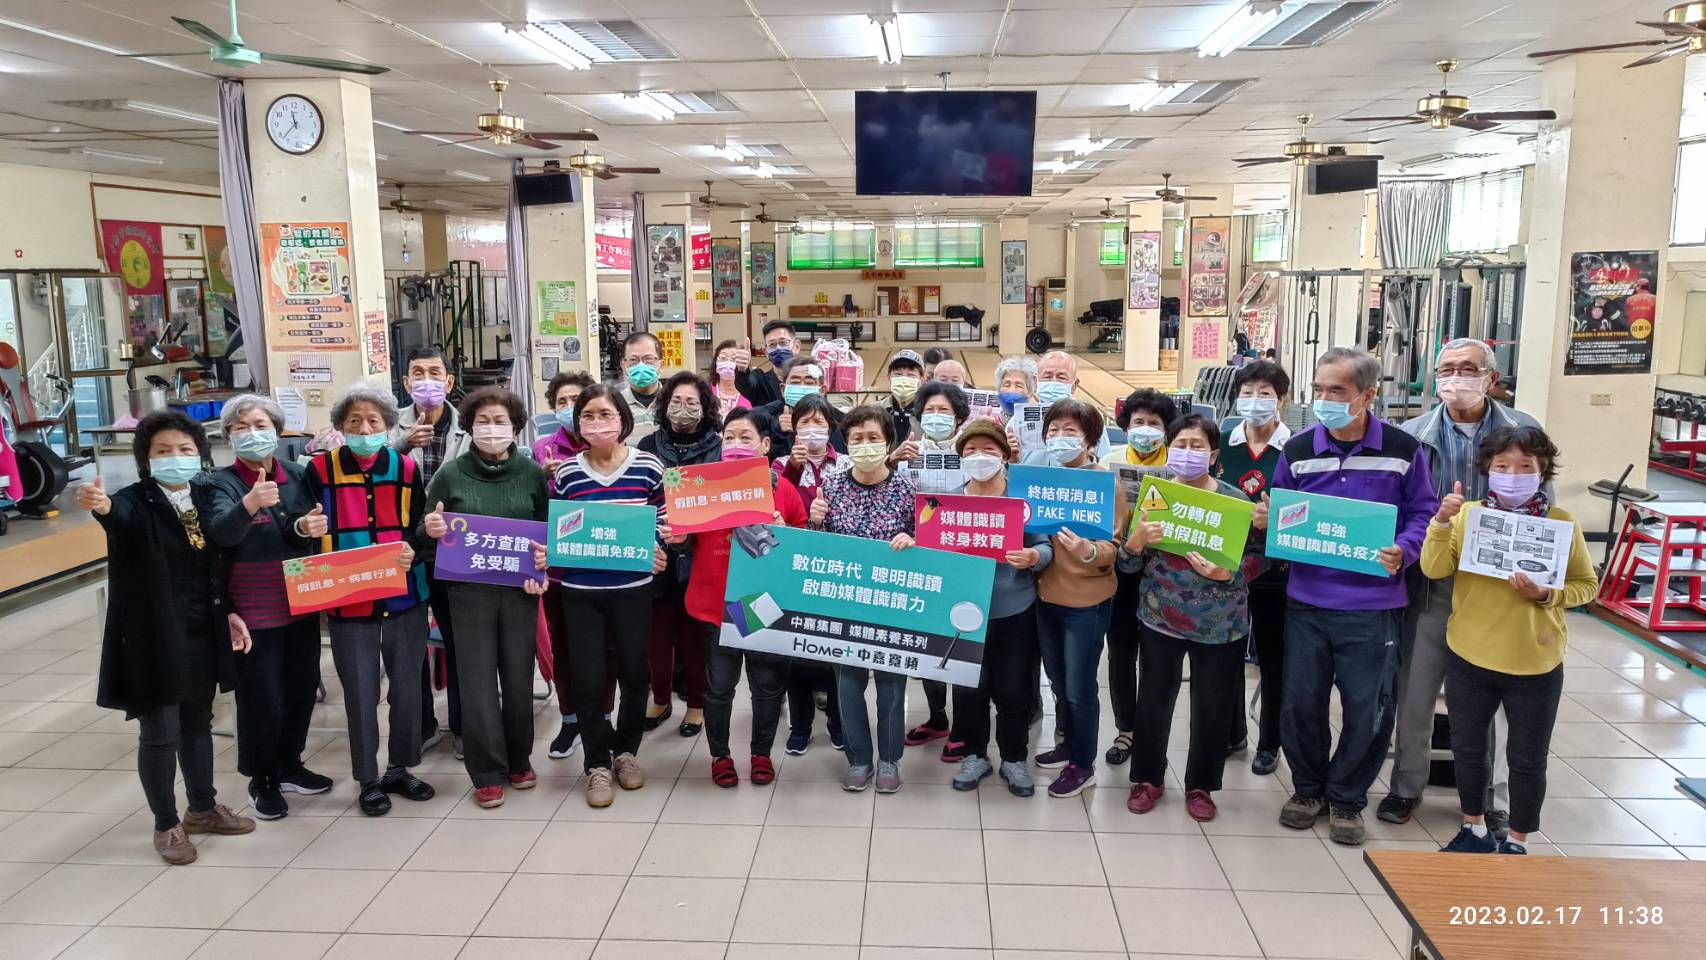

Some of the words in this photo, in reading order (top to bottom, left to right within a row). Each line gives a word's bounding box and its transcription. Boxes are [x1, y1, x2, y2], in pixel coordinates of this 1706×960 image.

[290, 101, 298, 109] 12
[674, 495, 708, 510] 假訊息
[720, 487, 765, 503] 病毒行銷
[940, 510, 1005, 529] 媒體識讀
[1037, 505, 1065, 520] FAKE
[1072, 508, 1102, 523] NEWS
[1172, 501, 1223, 528] 勿轉傳
[590, 527, 617, 540] 增強
[1316, 521, 1347, 539] 增強
[464, 532, 530, 552] 多方查證
[940, 531, 1005, 549] 終身教育
[556, 542, 648, 559] 媒體識讀免疫力
[470, 553, 520, 572] 免受騙
[297, 579, 335, 593] 假訊息
[349, 567, 397, 583] 病毒行銷
[791, 553, 863, 580] 數位時代
[871, 565, 943, 594] 聰明識讀
[802, 578, 925, 613] 啟動媒體識讀力
[790, 616, 843, 636] 中嘉集團
[849, 624, 928, 650] 媒體素養系列
[857, 648, 919, 671] 中嘉寬頻
